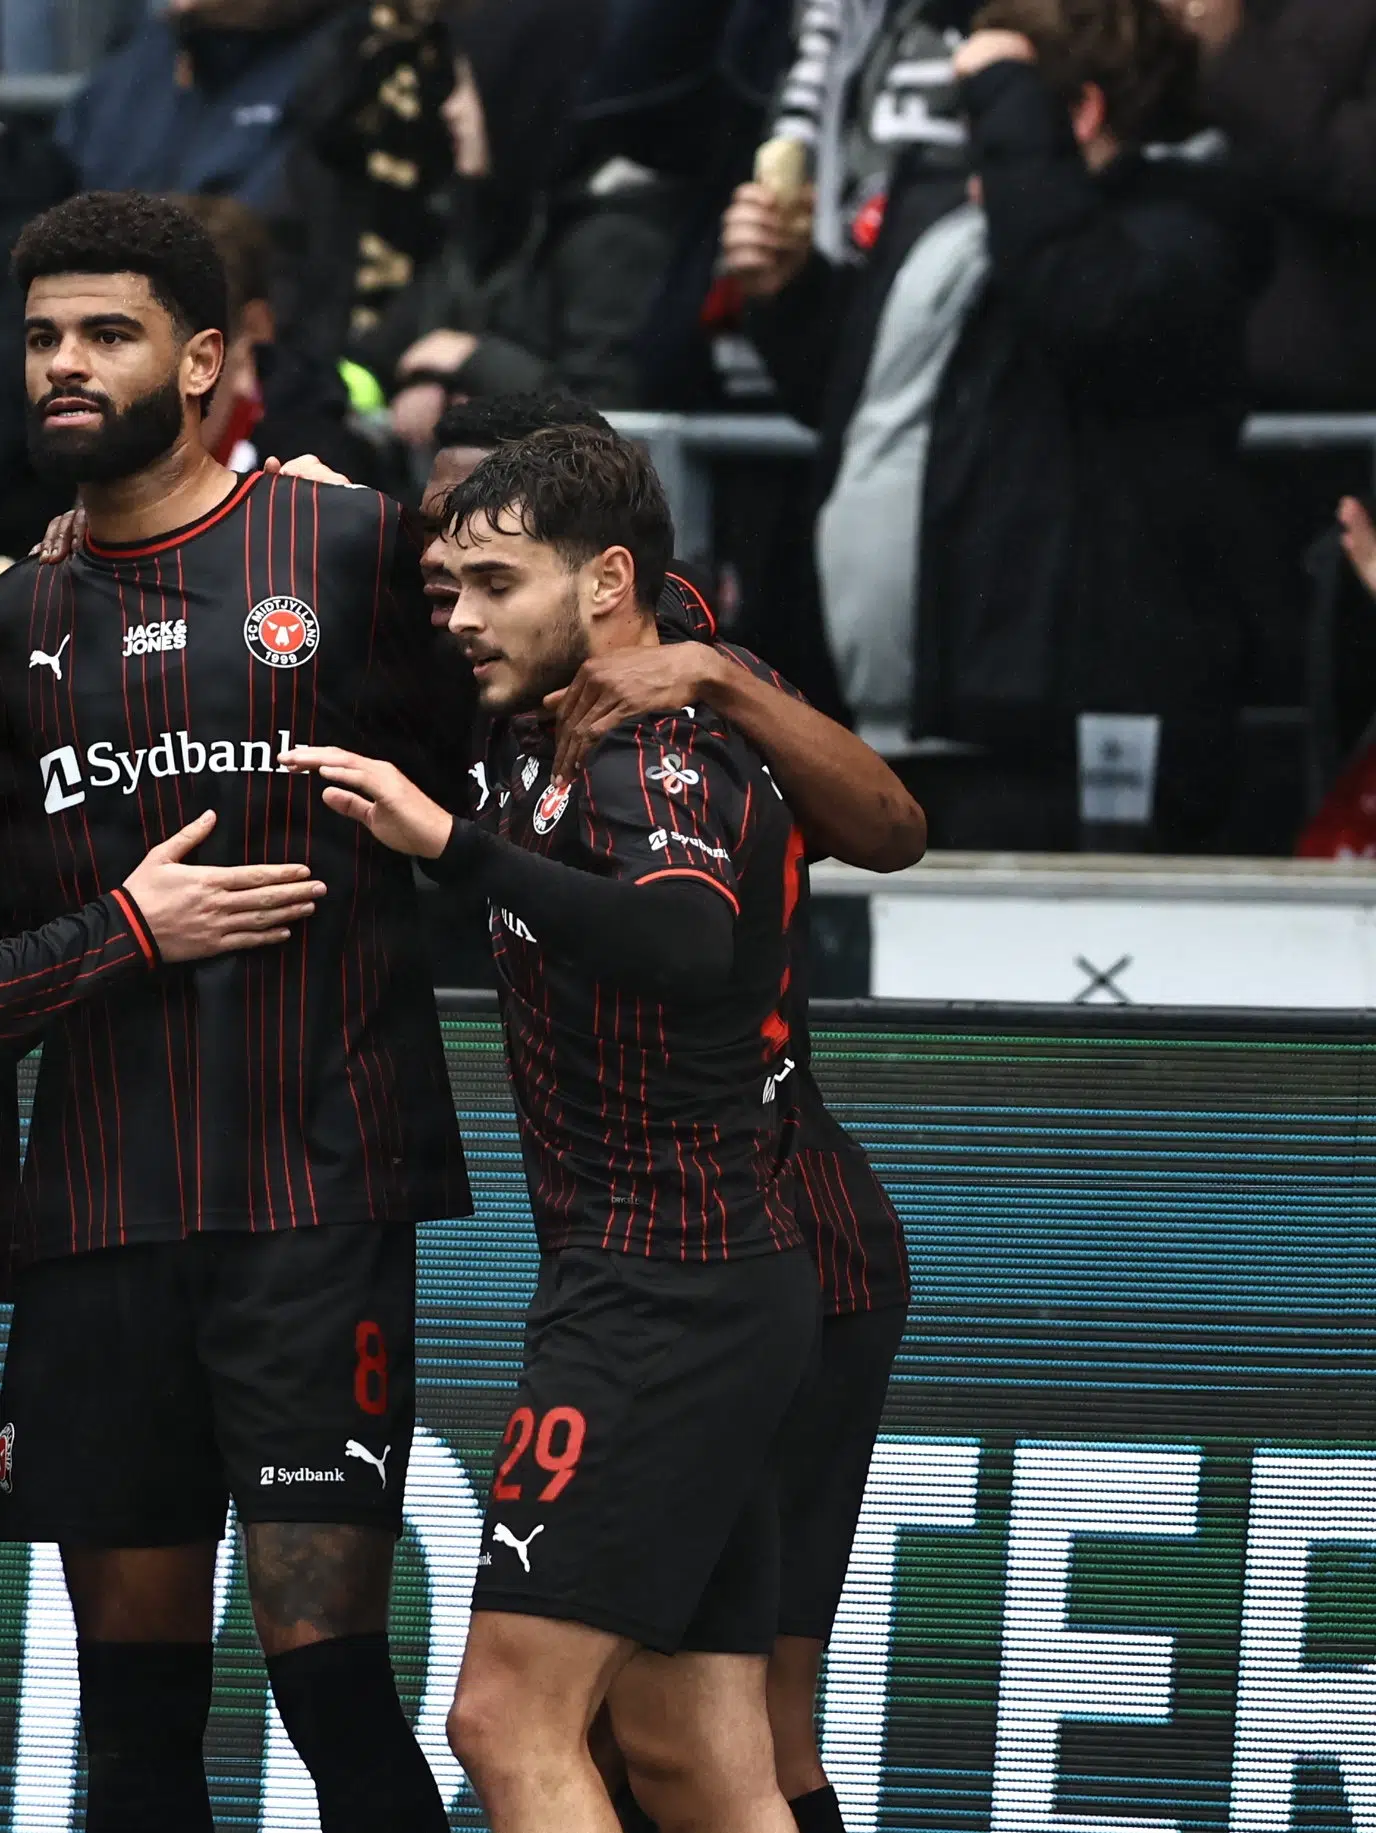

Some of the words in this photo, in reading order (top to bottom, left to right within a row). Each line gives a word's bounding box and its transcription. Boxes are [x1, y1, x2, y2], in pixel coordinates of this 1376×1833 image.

[251, 599, 317, 648] MIDTJYLLAND
[122, 633, 187, 657] JONES
[265, 651, 298, 665] 1999
[353, 1320, 389, 1415] 8
[493, 1405, 587, 1503] 29
[277, 1467, 346, 1486] Sydbank
